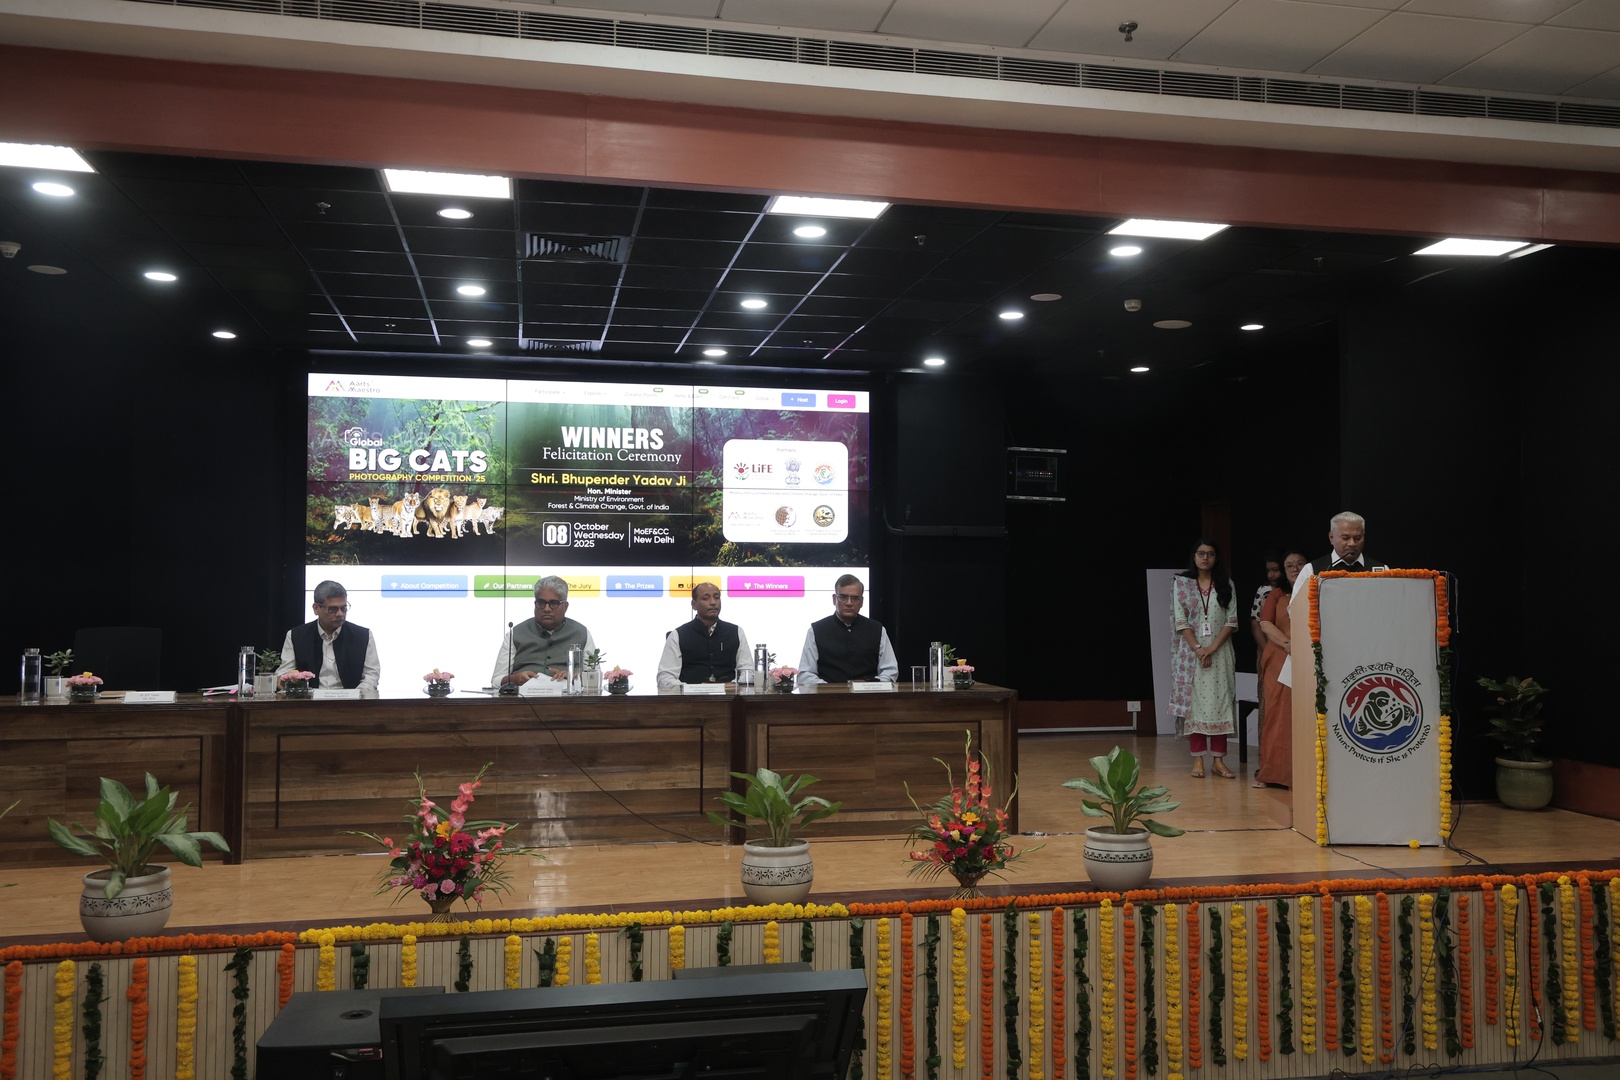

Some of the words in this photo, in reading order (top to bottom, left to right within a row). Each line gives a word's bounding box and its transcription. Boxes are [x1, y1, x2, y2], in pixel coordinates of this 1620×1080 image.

[350, 437, 383, 447] Global
[561, 426, 664, 450] WINNERS
[349, 449, 401, 471] BIG
[409, 450, 488, 473] CATS
[543, 447, 613, 461] Felicitation
[617, 449, 682, 465] Ceremony
[752, 464, 773, 473] LiFE
[349, 473, 413, 482] PHOTOGRAPHY
[415, 474, 472, 482] COMPETITION
[531, 473, 558, 484] Shri.
[562, 474, 630, 487] Bhupender
[633, 475, 672, 486] Yadav
[676, 475, 687, 486] Ji
[546, 525, 567, 544] 08
[574, 532, 624, 541] Wednesday
[1332, 723, 1350, 750] Nature
[1348, 747, 1376, 763] Protects
[1386, 755, 1401, 764] She
[1408, 724, 1431, 755] Protected
